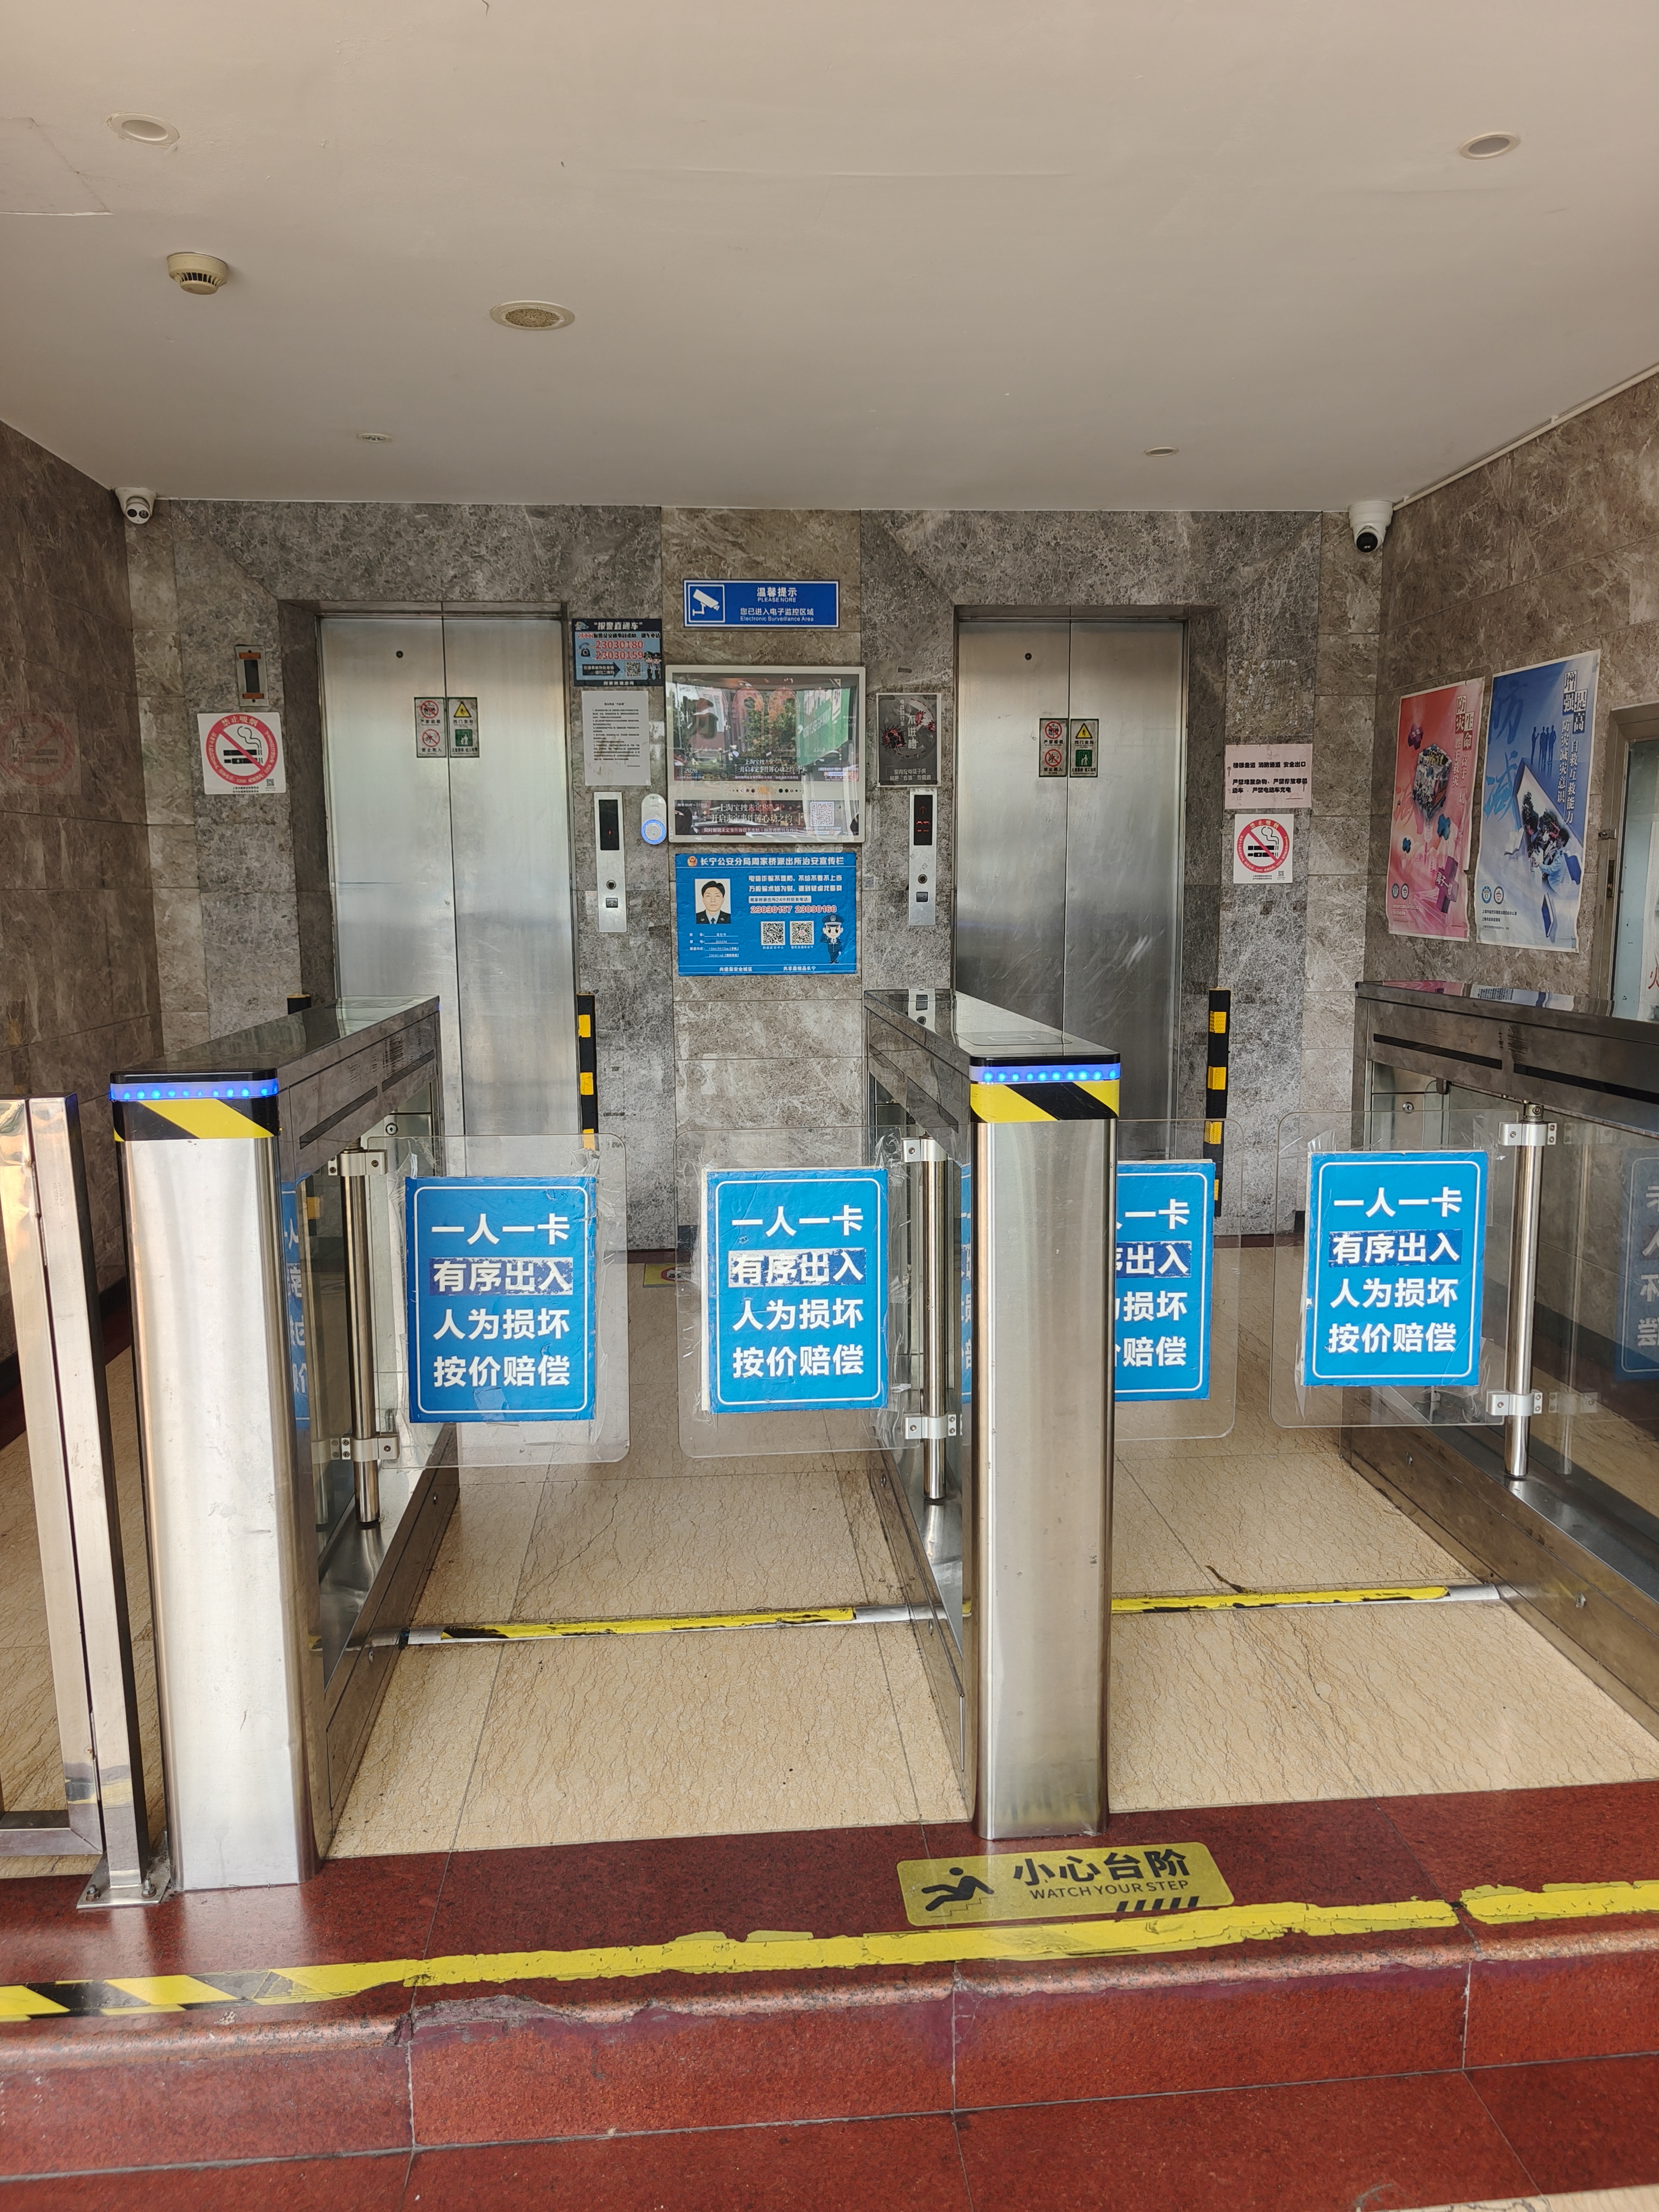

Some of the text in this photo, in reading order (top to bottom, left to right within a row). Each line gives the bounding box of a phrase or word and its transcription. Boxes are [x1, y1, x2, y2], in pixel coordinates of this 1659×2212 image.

[757, 587, 797, 597] 温馨提示
[740, 608, 814, 616] 您已进入电子监控区域
[595, 640, 643, 649] 23030180
[595, 651, 644, 659] 23030159
[221, 716, 258, 727] 禁止吸烟
[907, 716, 919, 750] 不进楼
[1566, 690, 1586, 824] 提高自救互救能力
[1250, 820, 1279, 829] 禁止吸烟
[700, 857, 844, 866] 长宁公安分局周家桥派出所治安宣传栏
[795, 905, 837, 913] 23030160
[1116, 1198, 1190, 1229] 一卡
[1334, 1187, 1462, 1217] 一人一卡
[431, 1213, 570, 1245] 一人一卡
[732, 1205, 864, 1237] 一人一卡
[1332, 1233, 1460, 1264] 有序出入
[433, 1260, 572, 1292] 有序出入
[731, 1251, 864, 1284] 有序出入
[1115, 1291, 1188, 1321] 损坏
[1330, 1278, 1458, 1309] 人为损坏
[433, 1309, 570, 1340] 人为损坏
[732, 1298, 864, 1331] 人为损坏
[1115, 1336, 1187, 1367] 赔偿
[1327, 1322, 1456, 1353] 按价赔偿
[433, 1355, 570, 1387] 按价赔偿
[732, 1344, 864, 1379] 按价赔偿
[1013, 1849, 1190, 1886] 小心台阶
[1029, 1879, 1189, 1900] WATCH YOUR STEP
